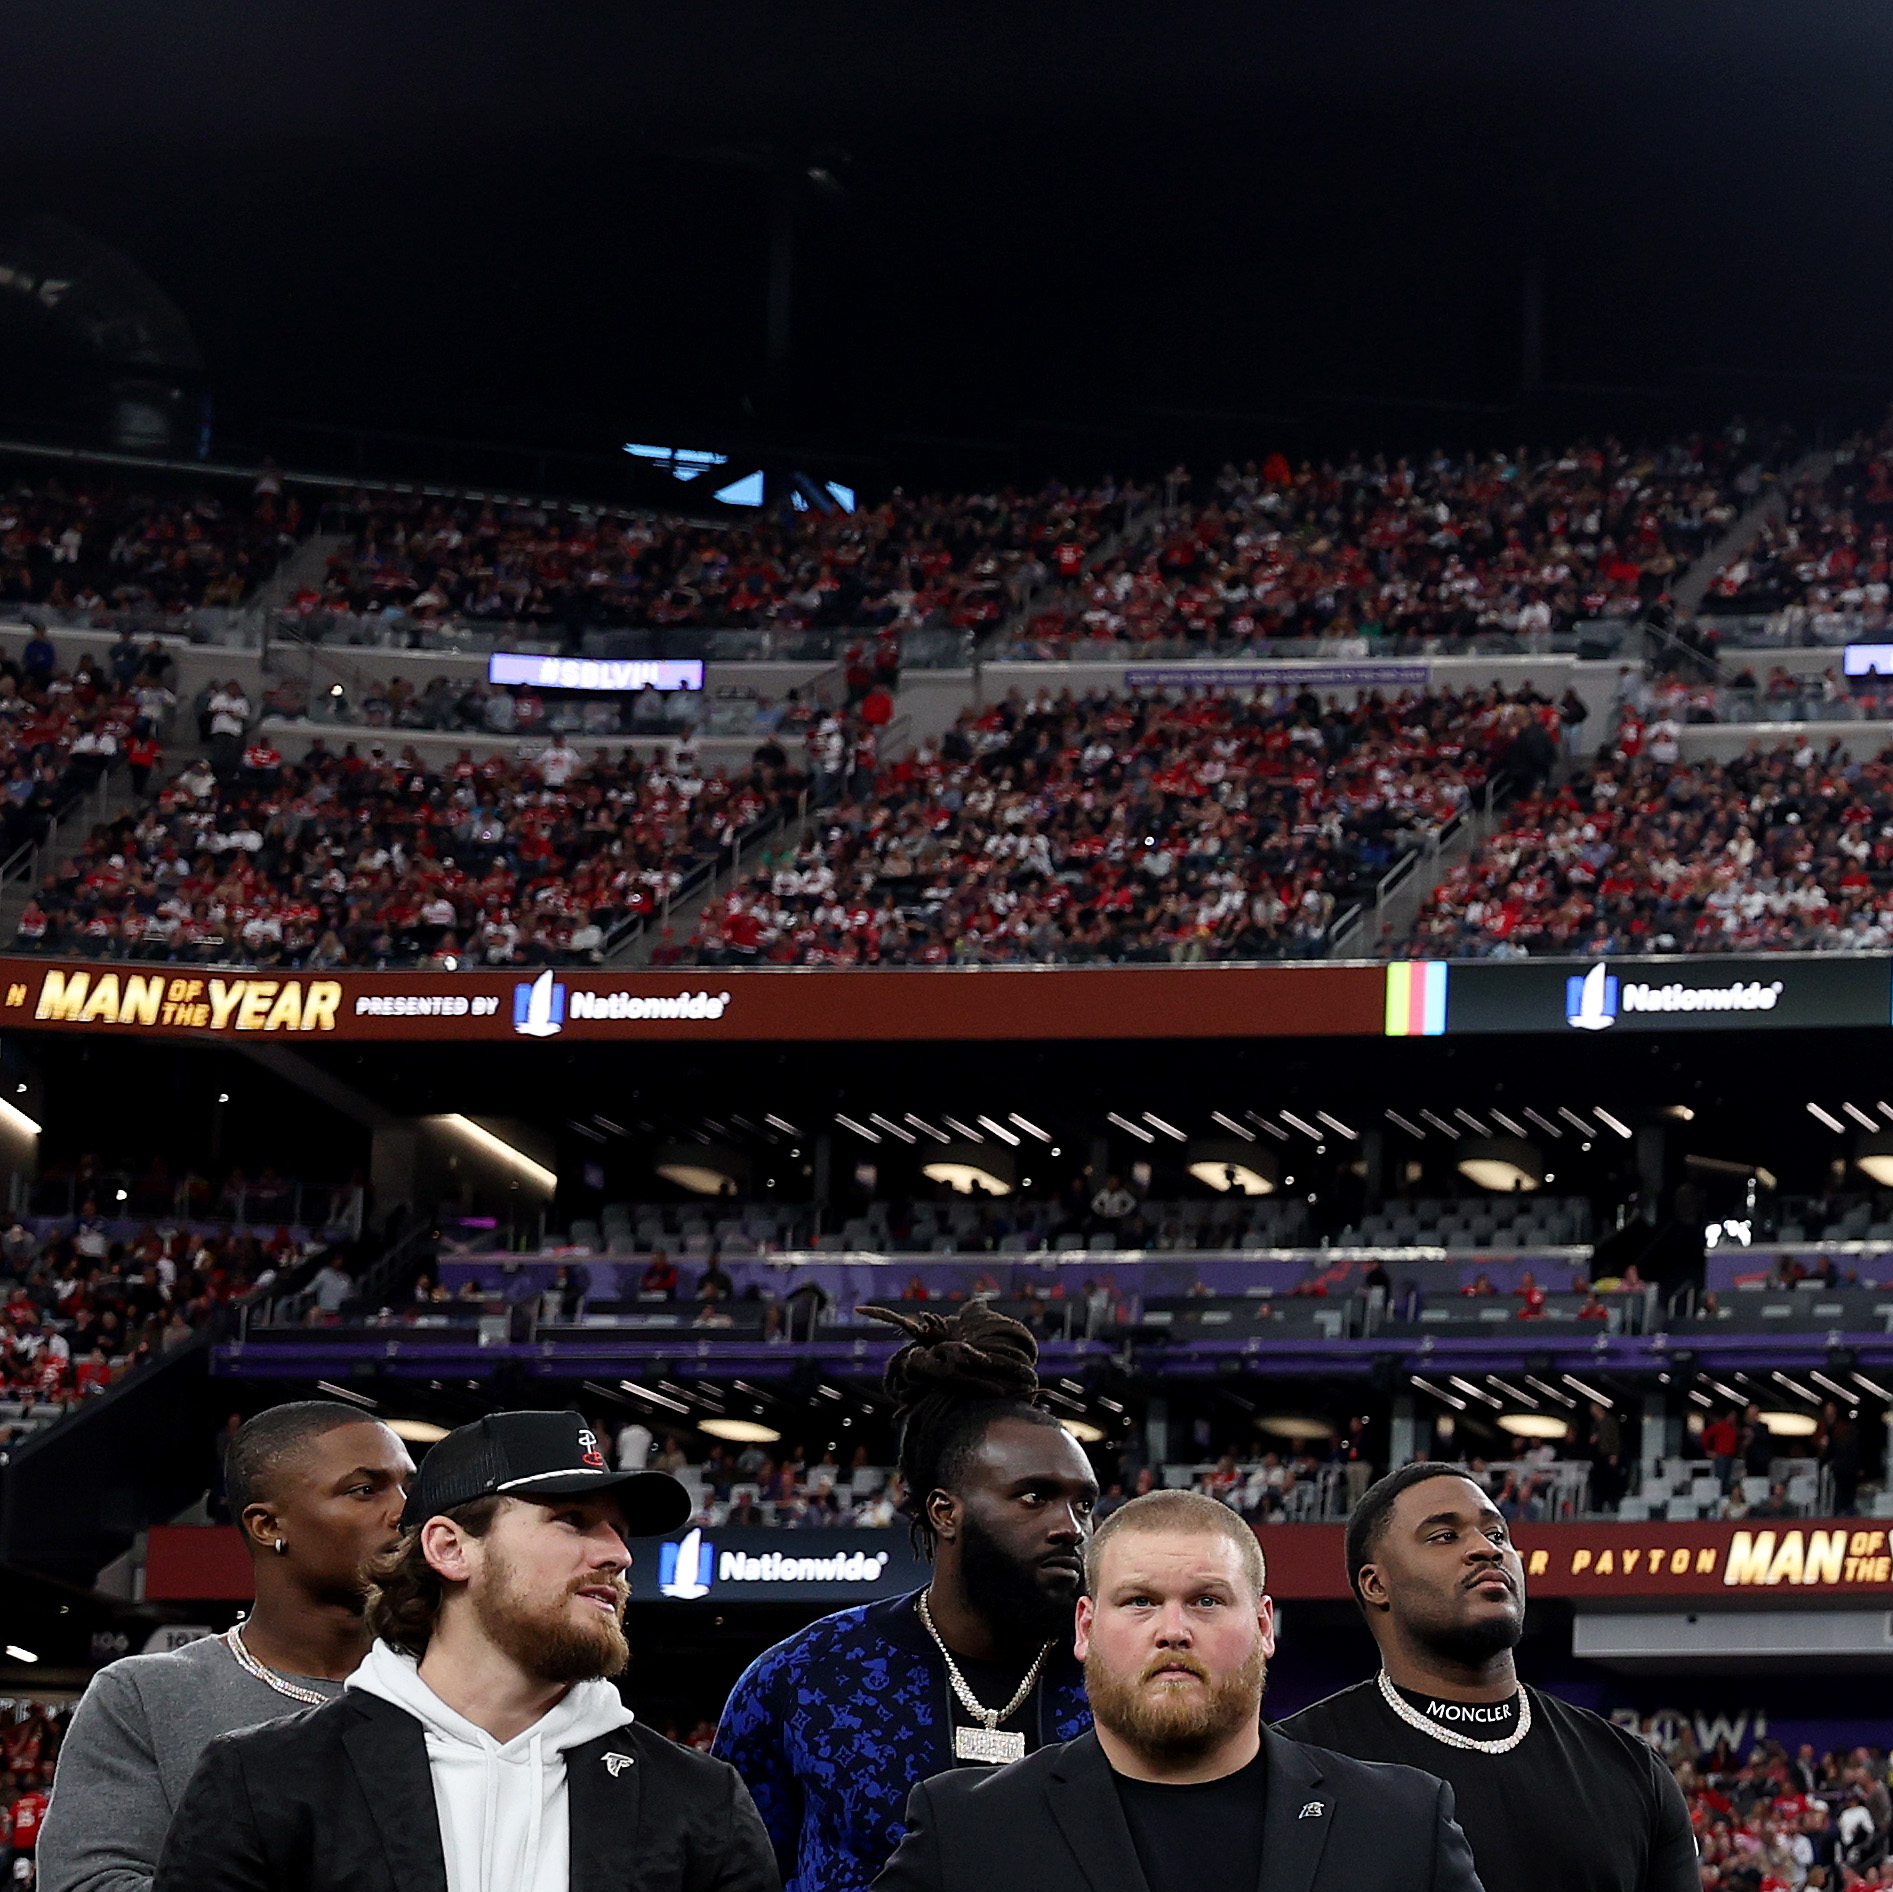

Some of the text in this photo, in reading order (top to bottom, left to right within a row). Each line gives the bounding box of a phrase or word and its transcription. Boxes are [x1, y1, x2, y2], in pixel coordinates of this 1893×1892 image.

[34, 969, 166, 1026] MAN
[166, 979, 204, 1003] OF
[161, 1003, 211, 1027] THE
[208, 979, 343, 1031] YEAR
[355, 996, 469, 1017] PRESENTED
[470, 996, 500, 1016] BY
[1850, 1531, 1885, 1557] OF
[1570, 1548, 1718, 1576] PAYTON
[1723, 1529, 1848, 1586] MAN
[1845, 1556, 1891, 1582] THE
[1426, 1700, 1512, 1722] MONCLER
